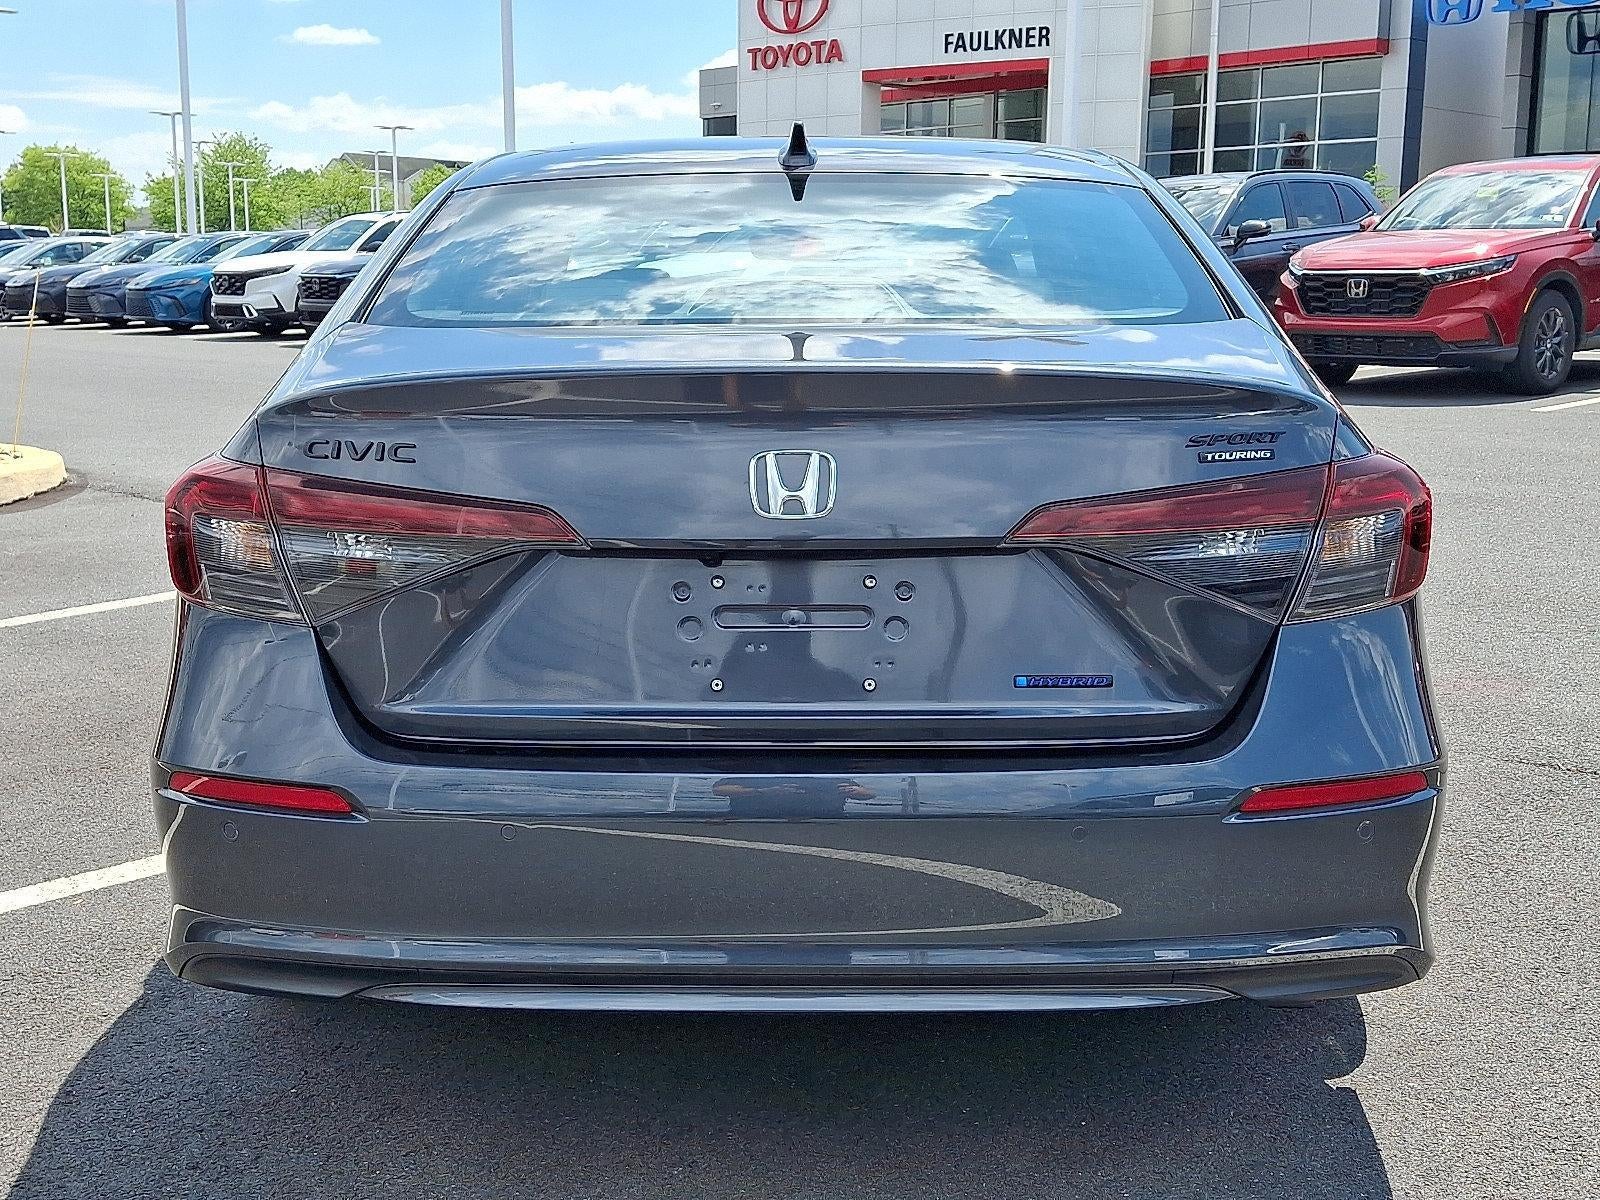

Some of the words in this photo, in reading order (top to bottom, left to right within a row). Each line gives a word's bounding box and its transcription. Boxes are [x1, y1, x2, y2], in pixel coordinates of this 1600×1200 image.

[944, 26, 1051, 54] FAULKNER
[747, 39, 844, 71] TOYOTA
[1184, 431, 1287, 448] SPORT
[302, 439, 417, 463] CIVIC
[1204, 450, 1272, 461] TOURING
[1029, 676, 1109, 687] HYBRID
